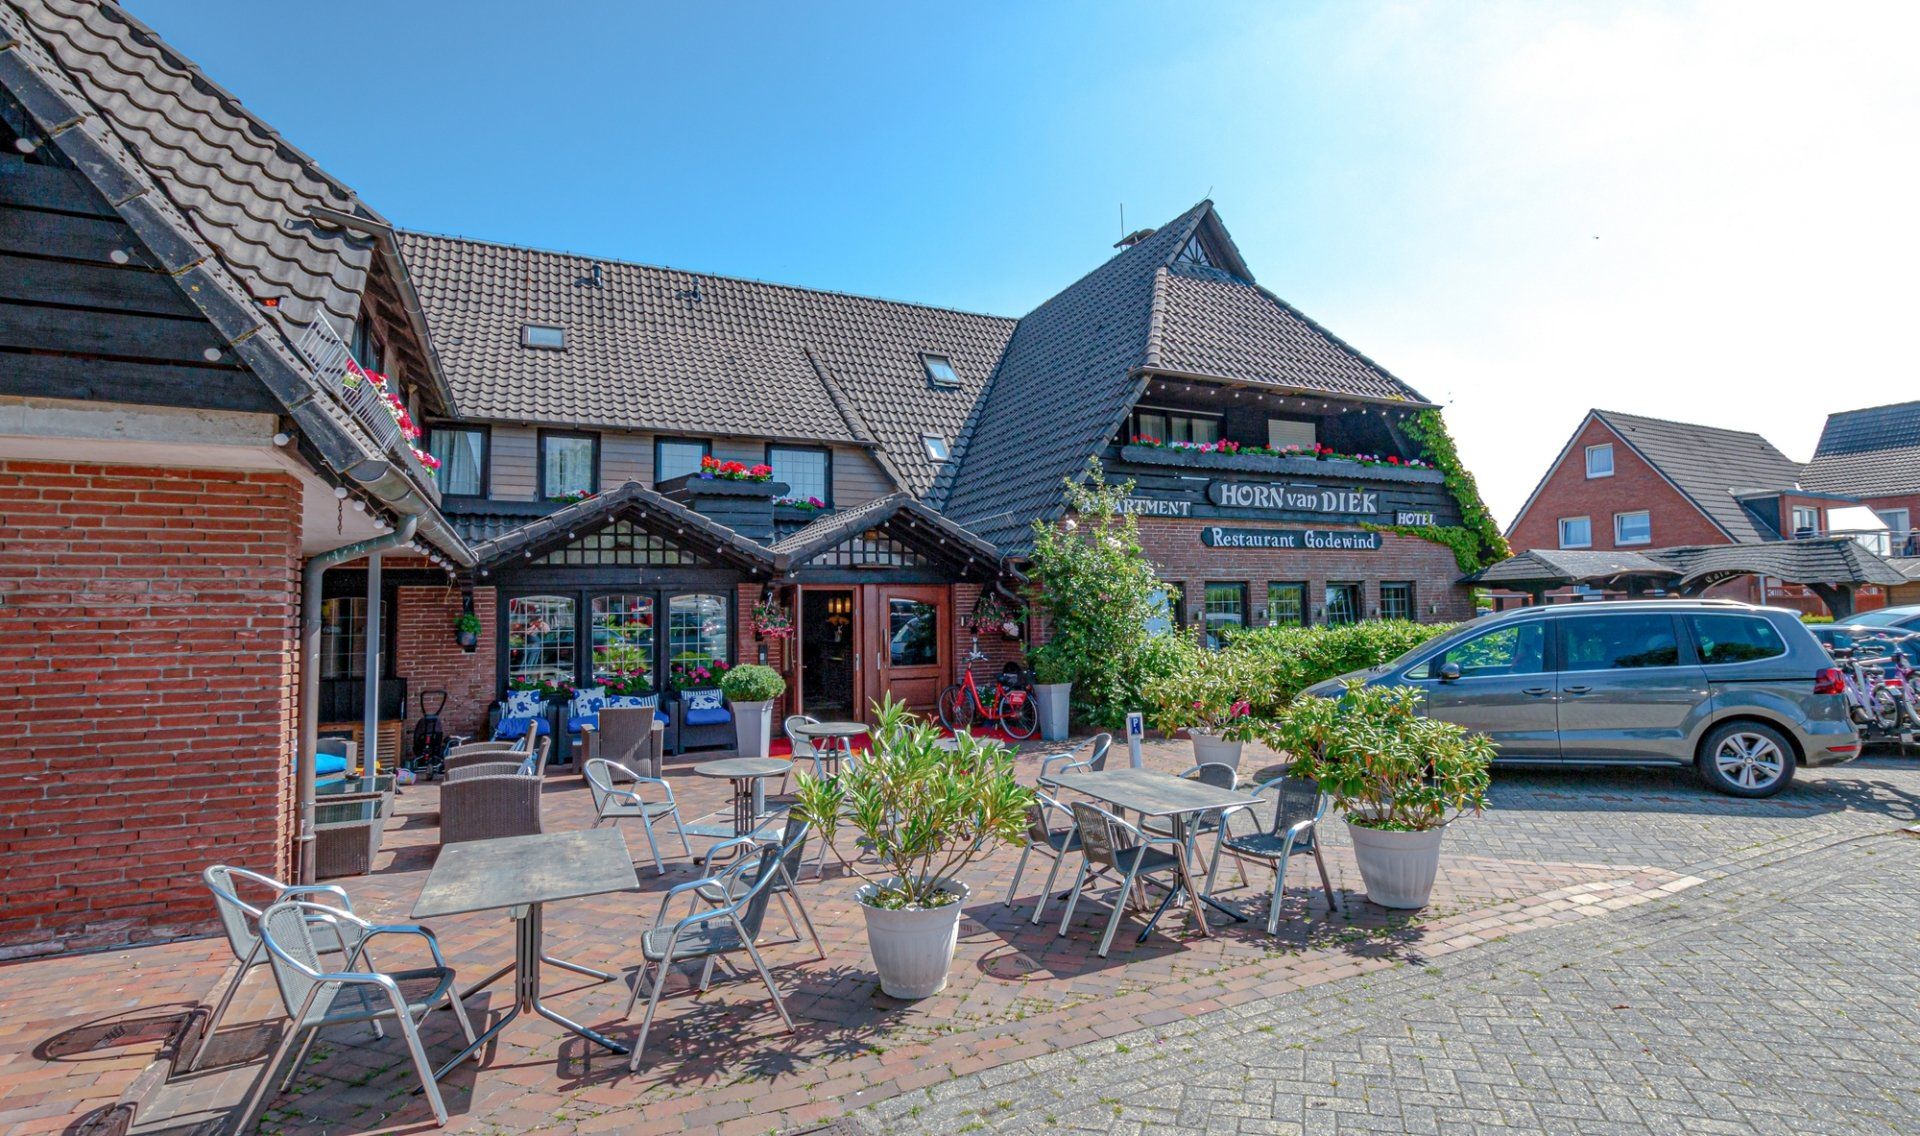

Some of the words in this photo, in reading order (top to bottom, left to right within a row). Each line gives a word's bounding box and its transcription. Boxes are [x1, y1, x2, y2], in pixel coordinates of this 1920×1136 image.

[1081, 499, 1192, 516] AARTMENT
[1220, 484, 1285, 508] HORN
[1286, 493, 1317, 510] van
[1320, 491, 1378, 513] DIEK
[1398, 512, 1436, 525] HOTEL
[1211, 527, 1295, 547] Restaurant
[1304, 530, 1375, 549] Godewind
